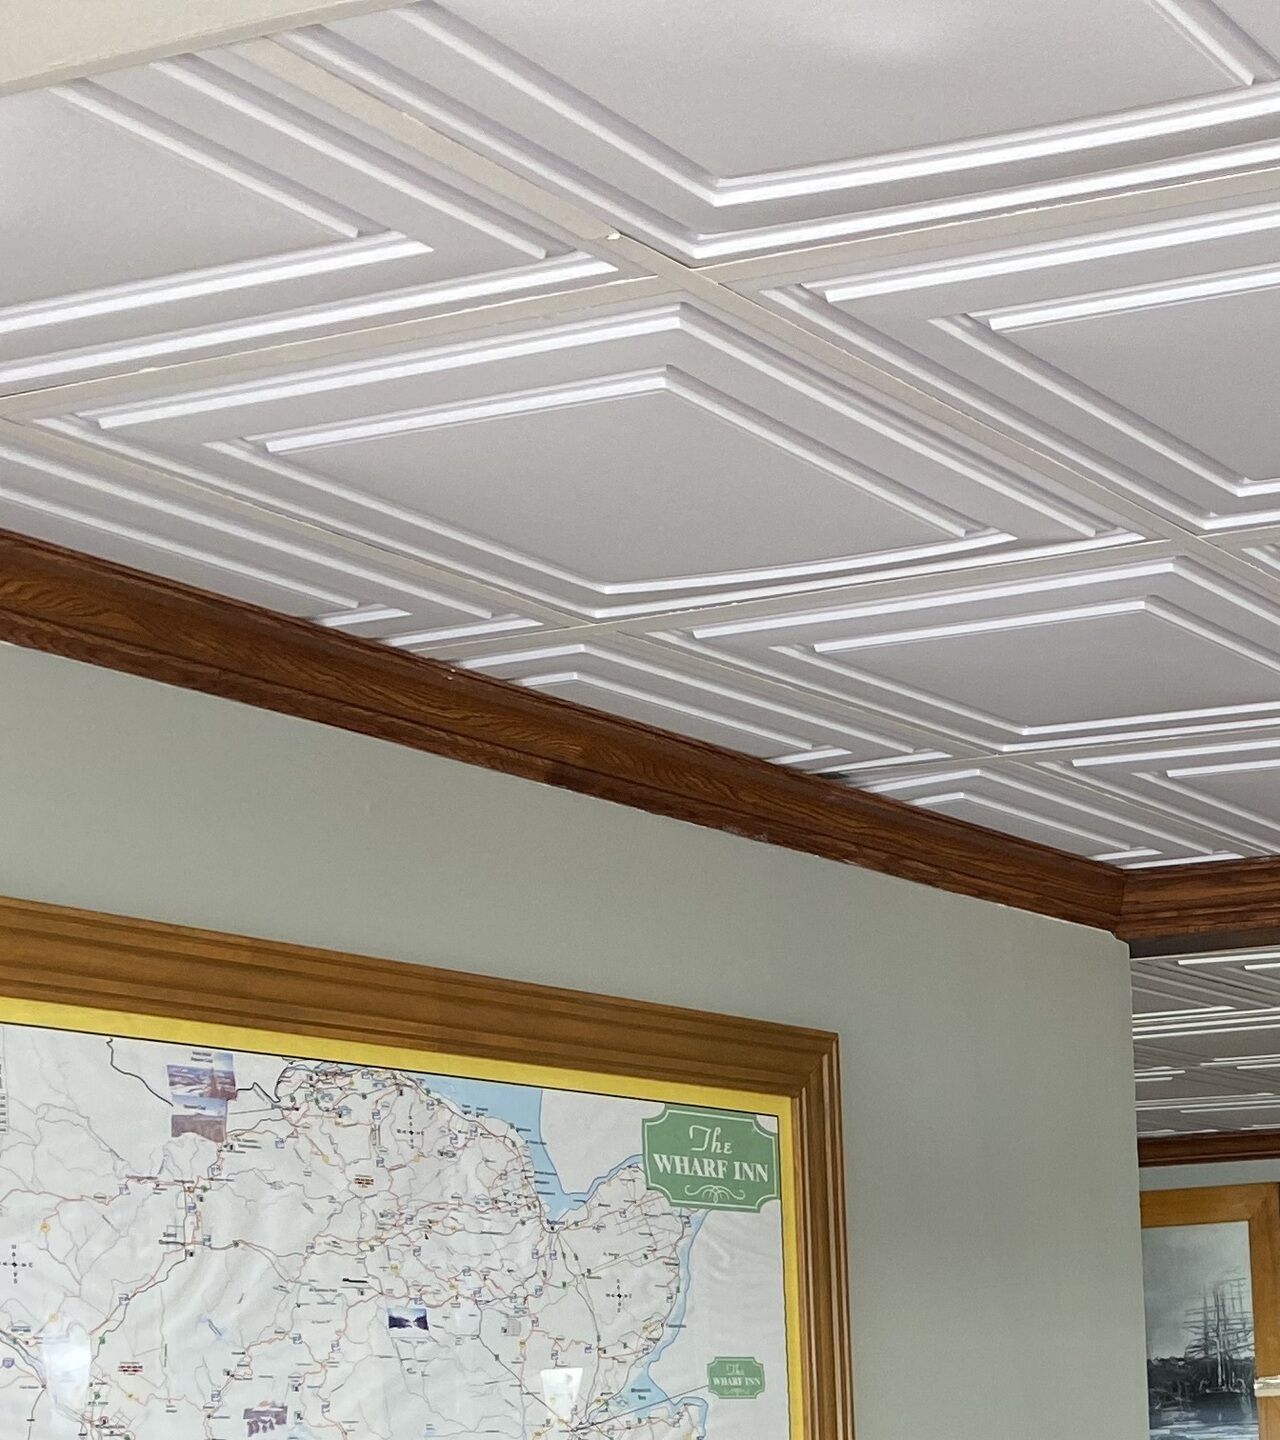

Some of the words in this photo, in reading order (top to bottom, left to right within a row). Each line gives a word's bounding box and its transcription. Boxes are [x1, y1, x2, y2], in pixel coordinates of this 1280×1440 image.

[689, 1125, 733, 1154] The
[653, 1153, 729, 1179] WHARF
[733, 1161, 769, 1182] INN
[712, 1376, 742, 1386] WHARF
[744, 1376, 761, 1386] INN
